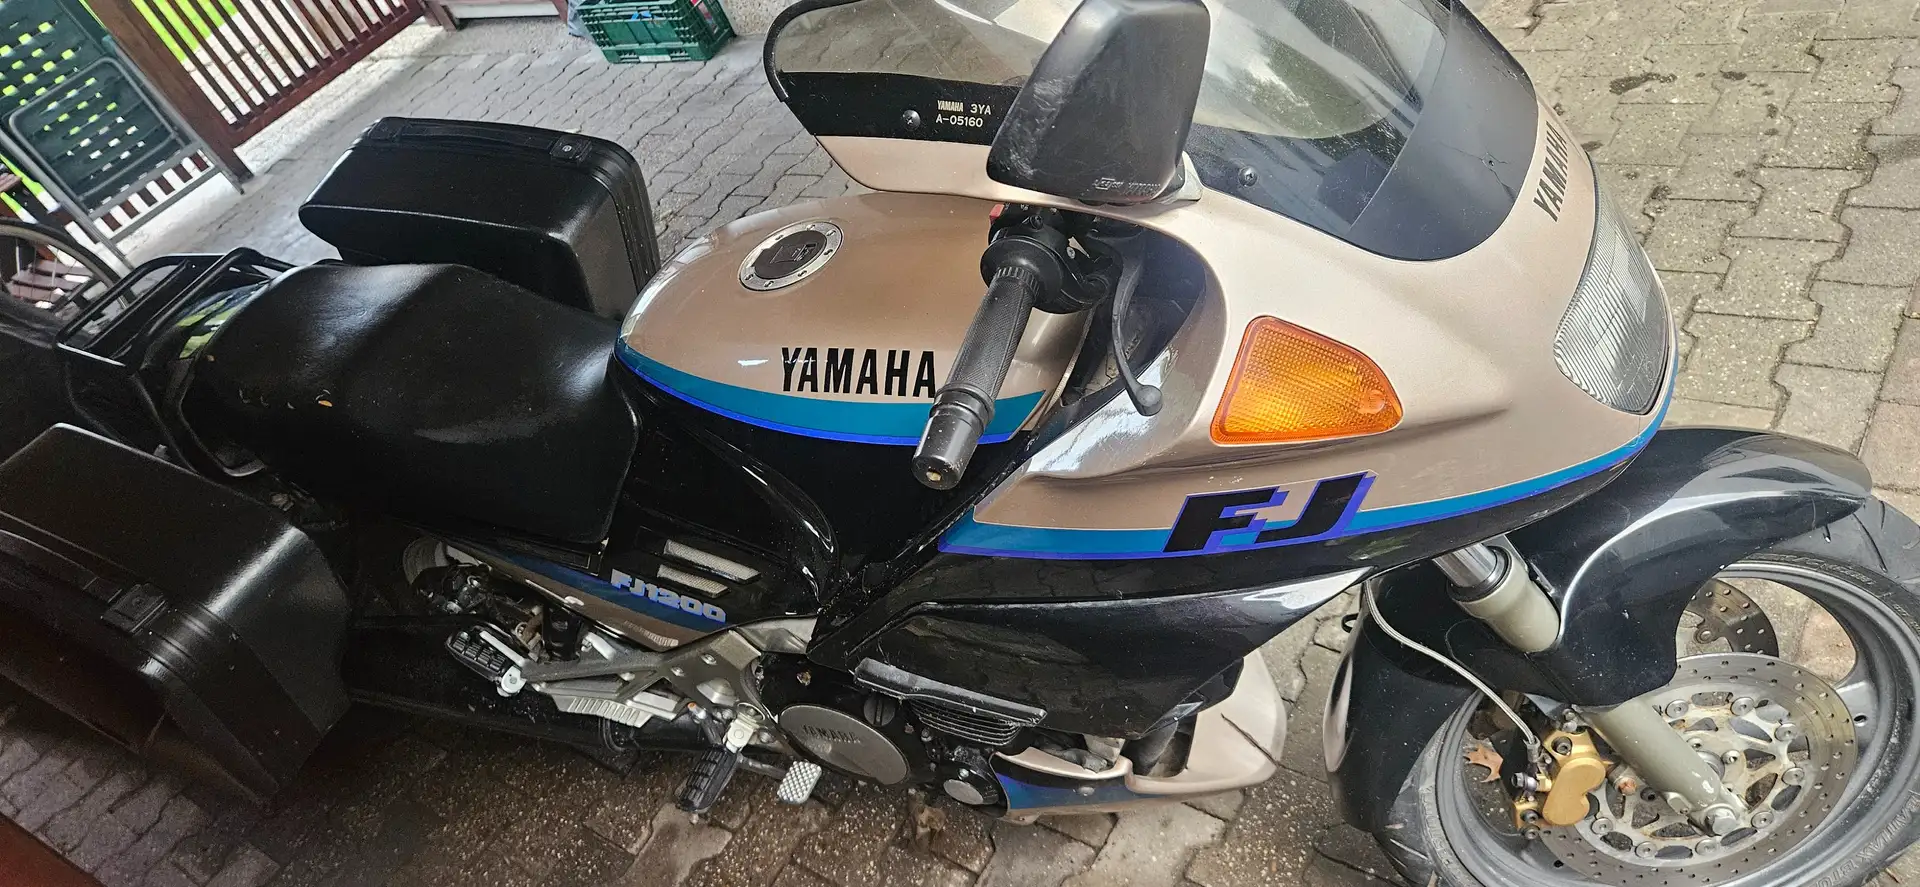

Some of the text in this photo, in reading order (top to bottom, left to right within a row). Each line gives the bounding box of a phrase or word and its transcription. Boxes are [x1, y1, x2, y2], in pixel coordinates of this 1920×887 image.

[935, 113, 984, 127] A-05160
[937, 99, 992, 115] YAMAHA 3YA
[1533, 120, 1568, 223] YAMAHA
[781, 346, 936, 398] YAMAHA
[1162, 471, 1375, 553] FJ
[610, 568, 726, 623] FJ1200
